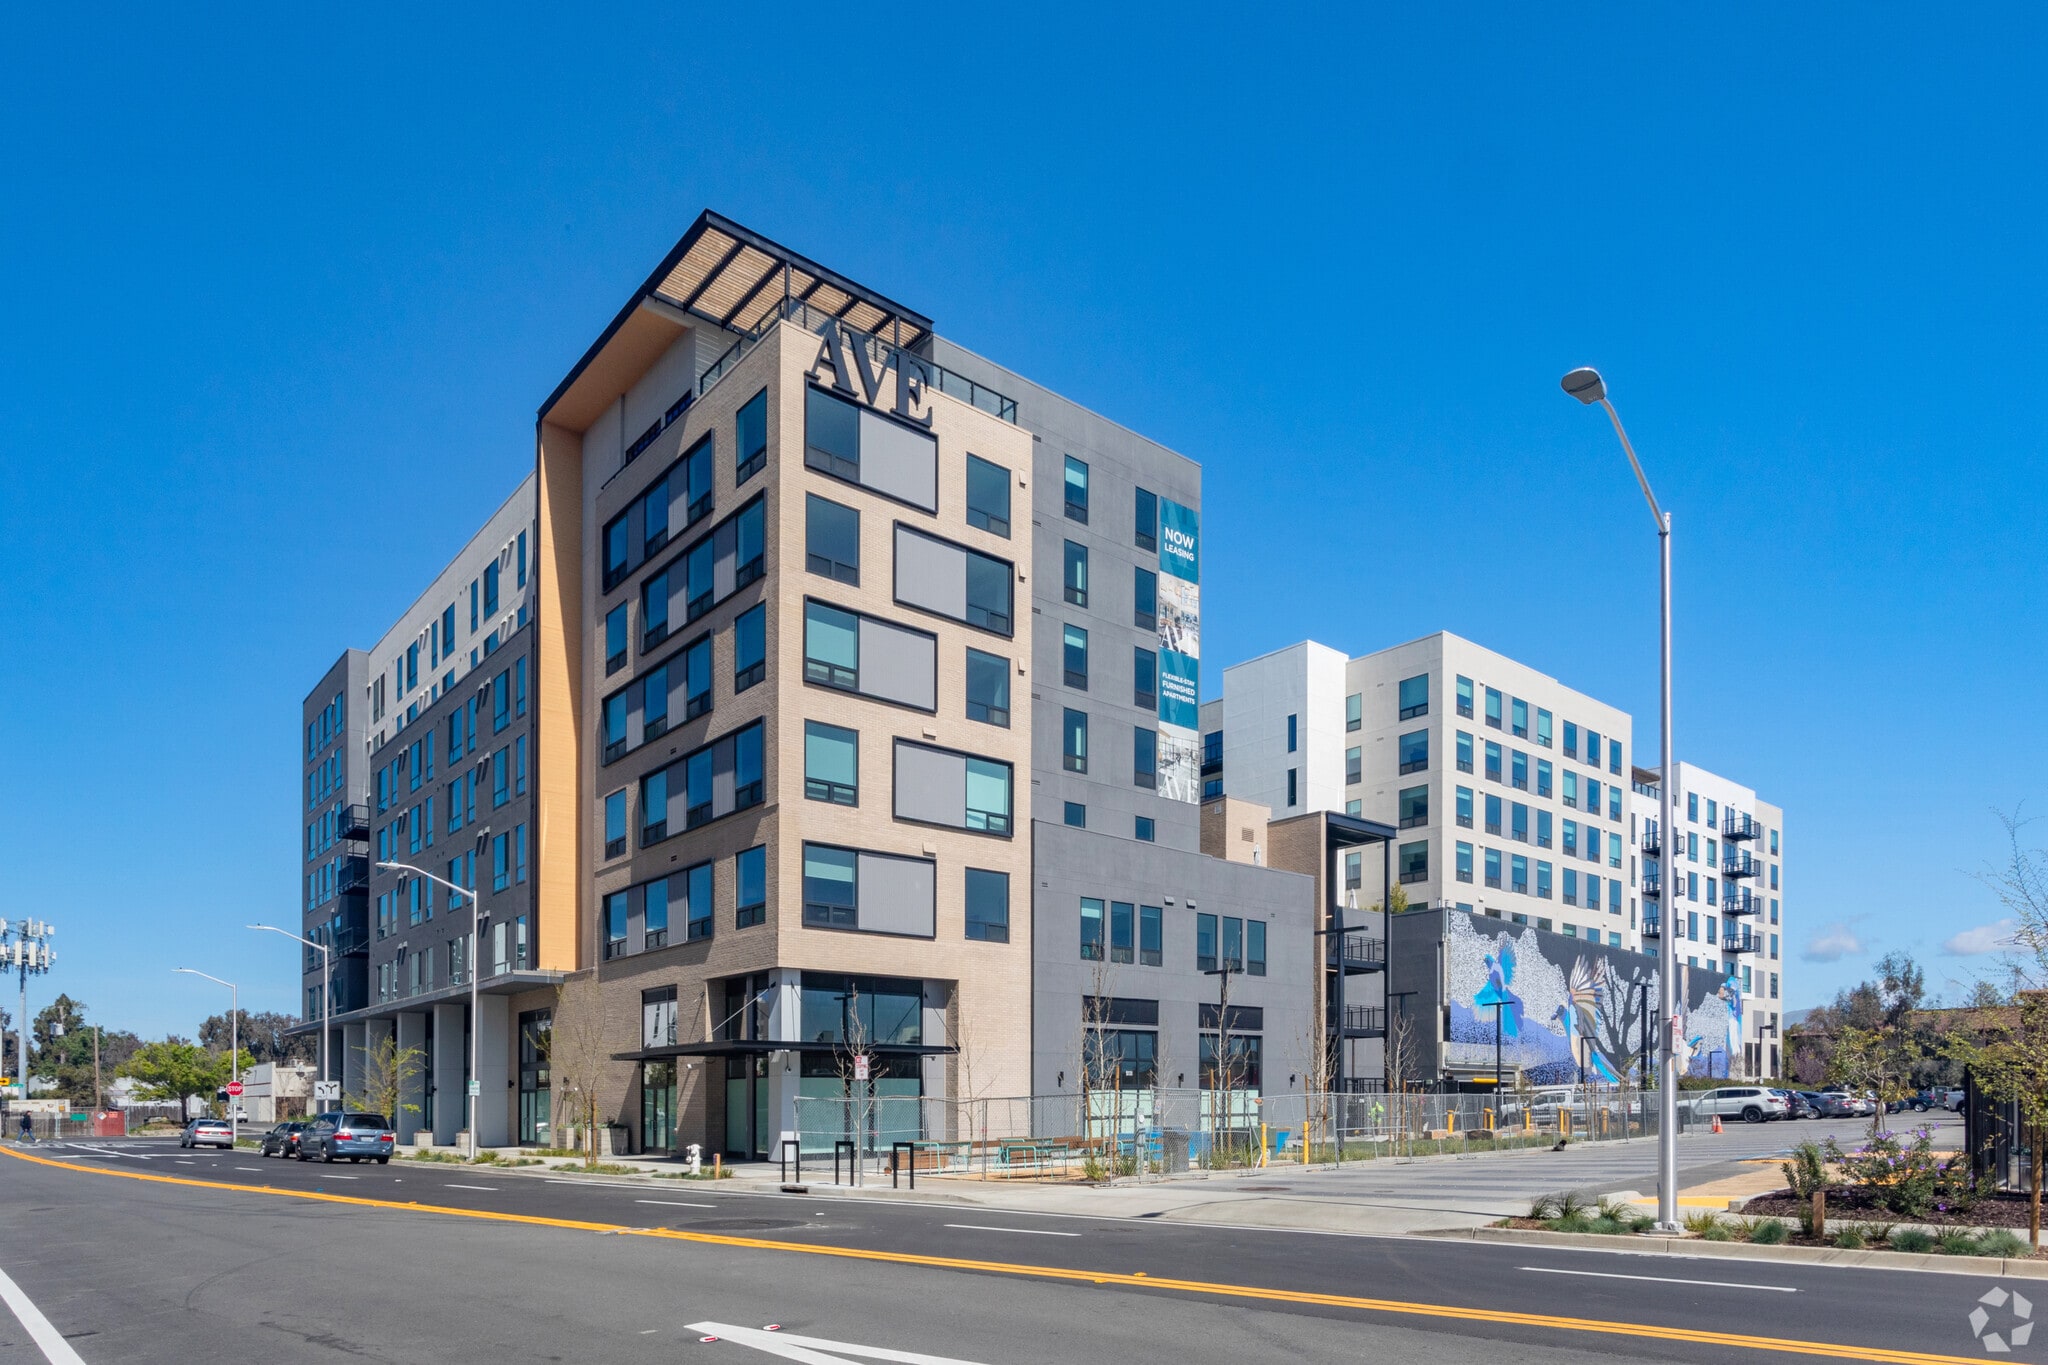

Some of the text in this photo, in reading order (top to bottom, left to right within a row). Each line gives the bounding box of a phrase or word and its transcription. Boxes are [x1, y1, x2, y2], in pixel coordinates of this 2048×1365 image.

[804, 317, 933, 429] AVE
[1165, 526, 1194, 550] NOW
[1164, 542, 1195, 562] LEASING
[1162, 680, 1196, 696] FURNISHED
[1162, 689, 1196, 705] APARTMENTS
[227, 1085, 243, 1093] STOP
